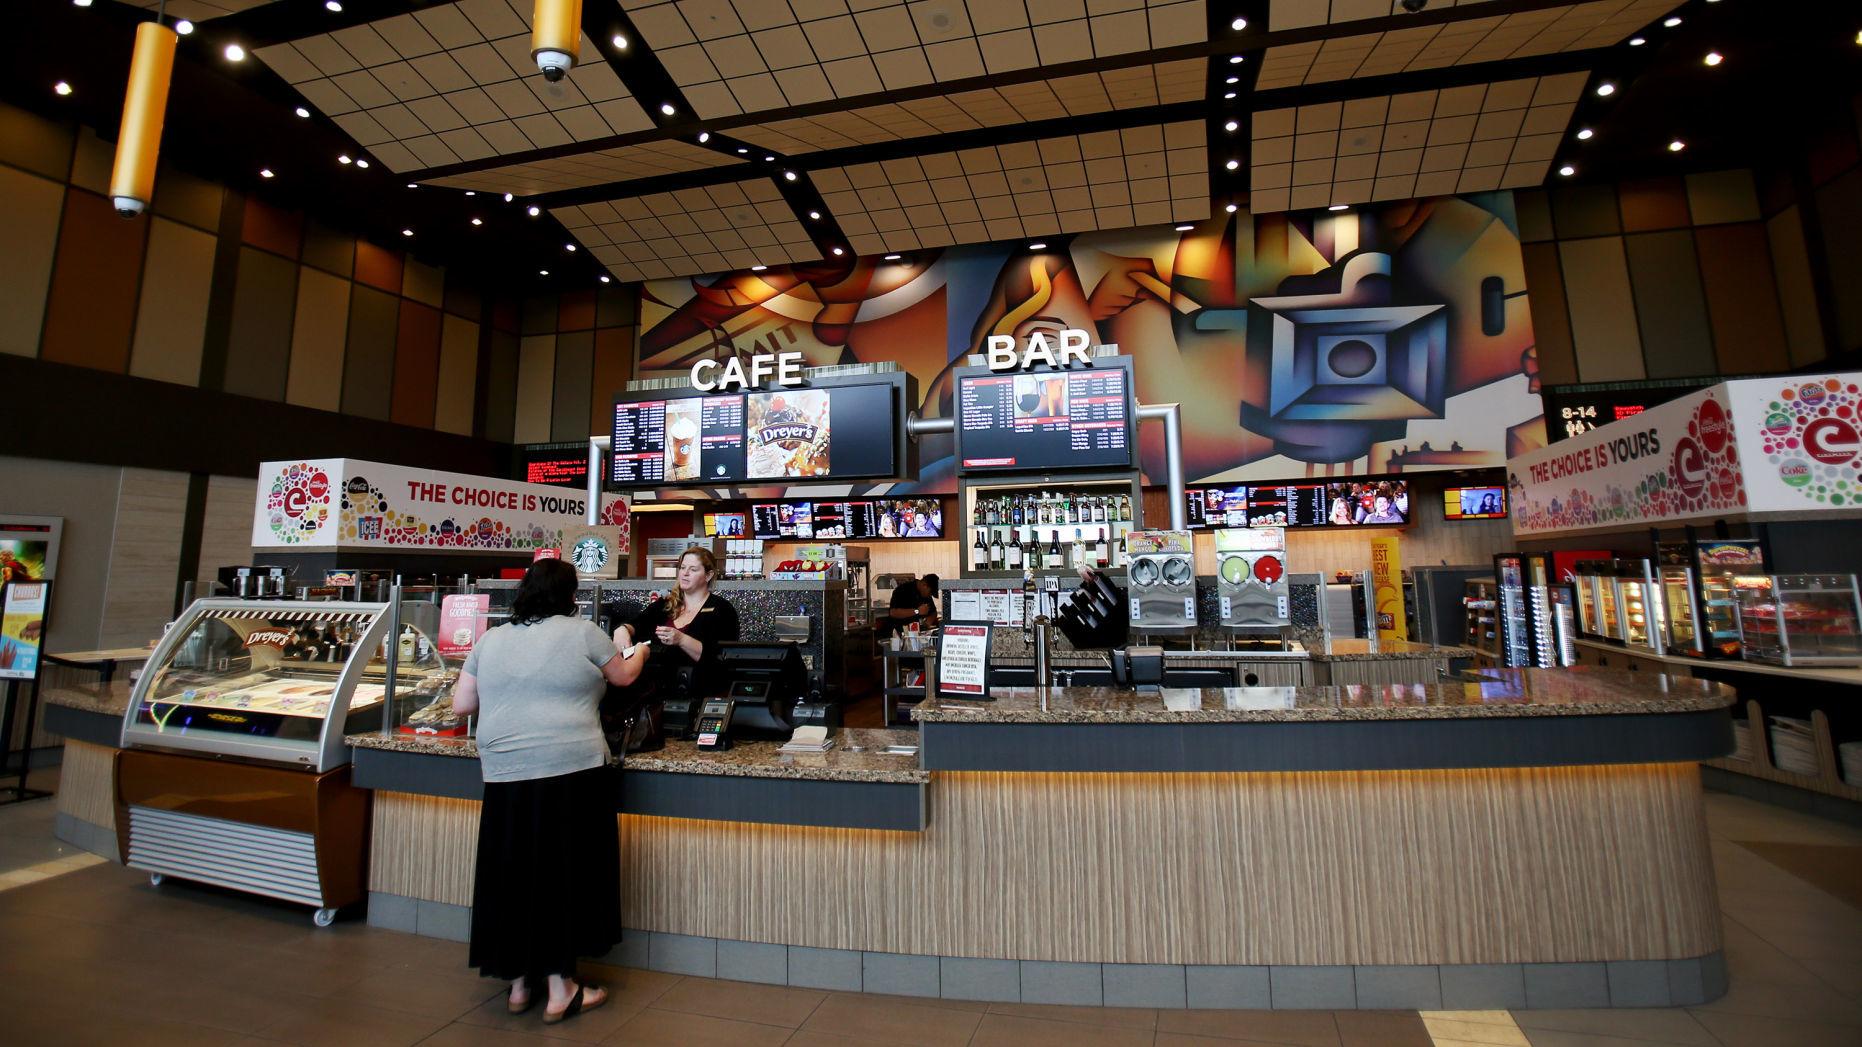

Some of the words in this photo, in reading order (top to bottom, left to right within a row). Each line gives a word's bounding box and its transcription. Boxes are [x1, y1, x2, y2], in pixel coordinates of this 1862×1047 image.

[988, 328, 1092, 371] BAR
[691, 351, 803, 392] CAFE
[1562, 405, 1598, 420] 8-14
[763, 425, 814, 442] Dreyer's
[1529, 461, 1550, 485] THE
[1550, 448, 1594, 480] CHOICE
[1594, 443, 1608, 469] IS
[1608, 427, 1661, 465] YOURS
[408, 480, 447, 504] THE
[451, 486, 518, 511] CHOICE
[522, 494, 537, 512] IS
[538, 495, 586, 517] YOURS
[361, 521, 381, 536] ICEE
[246, 629, 292, 646] Dreyer's
